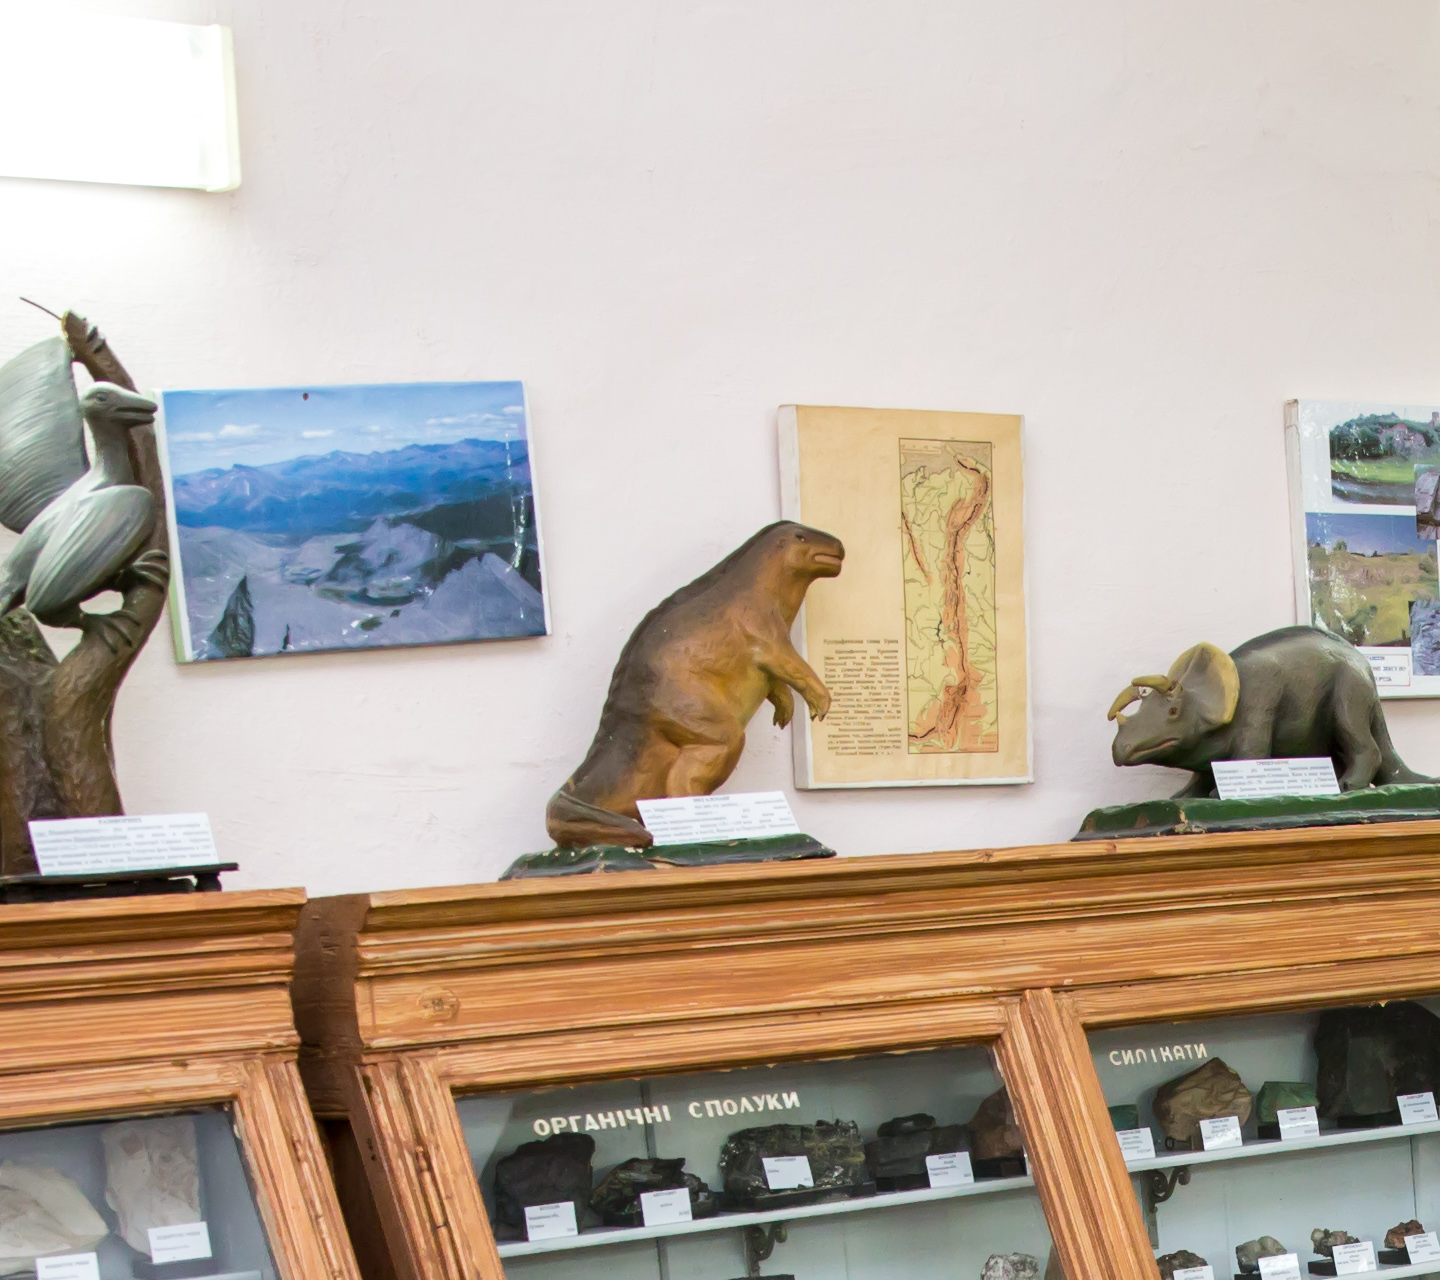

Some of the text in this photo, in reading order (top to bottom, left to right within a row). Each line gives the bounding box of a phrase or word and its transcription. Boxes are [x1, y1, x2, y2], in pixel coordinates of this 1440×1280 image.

[1109, 1042, 1208, 1066] СИЛІКАТИ
[533, 1091, 801, 1136] ОРГАНІЧНІ СПОЛУКИ
